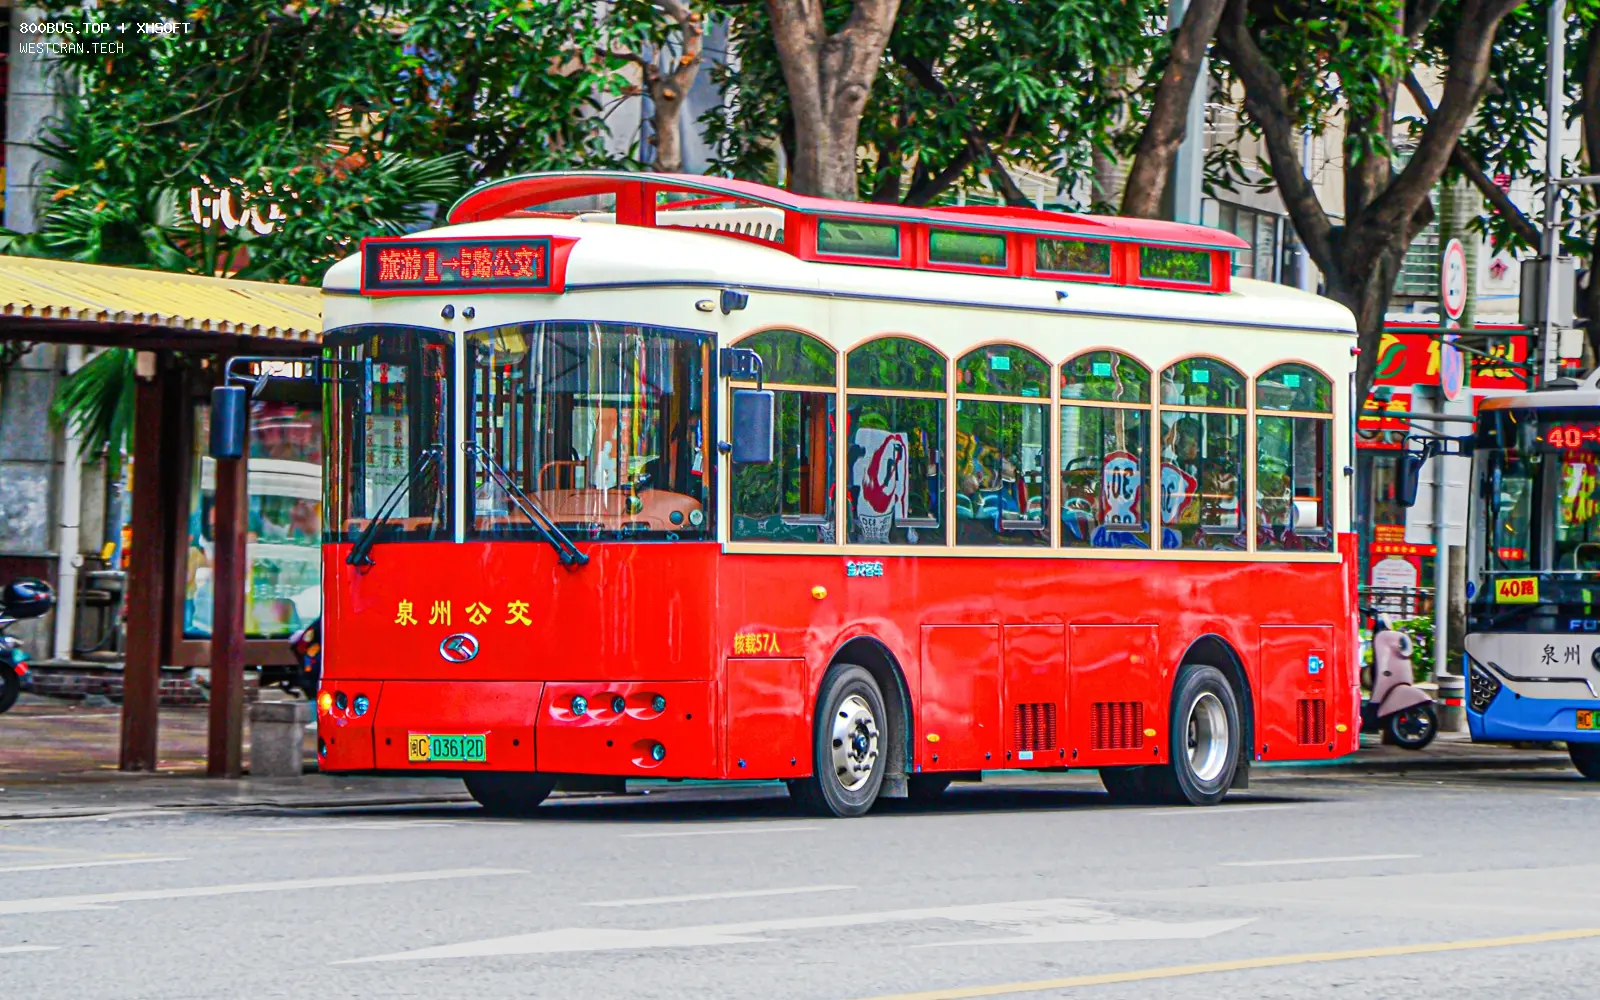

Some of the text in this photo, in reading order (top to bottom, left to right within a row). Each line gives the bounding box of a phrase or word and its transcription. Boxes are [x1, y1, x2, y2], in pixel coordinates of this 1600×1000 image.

[846, 560, 884, 577] 金龙客车
[1499, 579, 1535, 598] 40路
[394, 599, 533, 627] 泉州公交
[734, 632, 781, 655] 核载57人
[1541, 644, 1581, 666] 泉州
